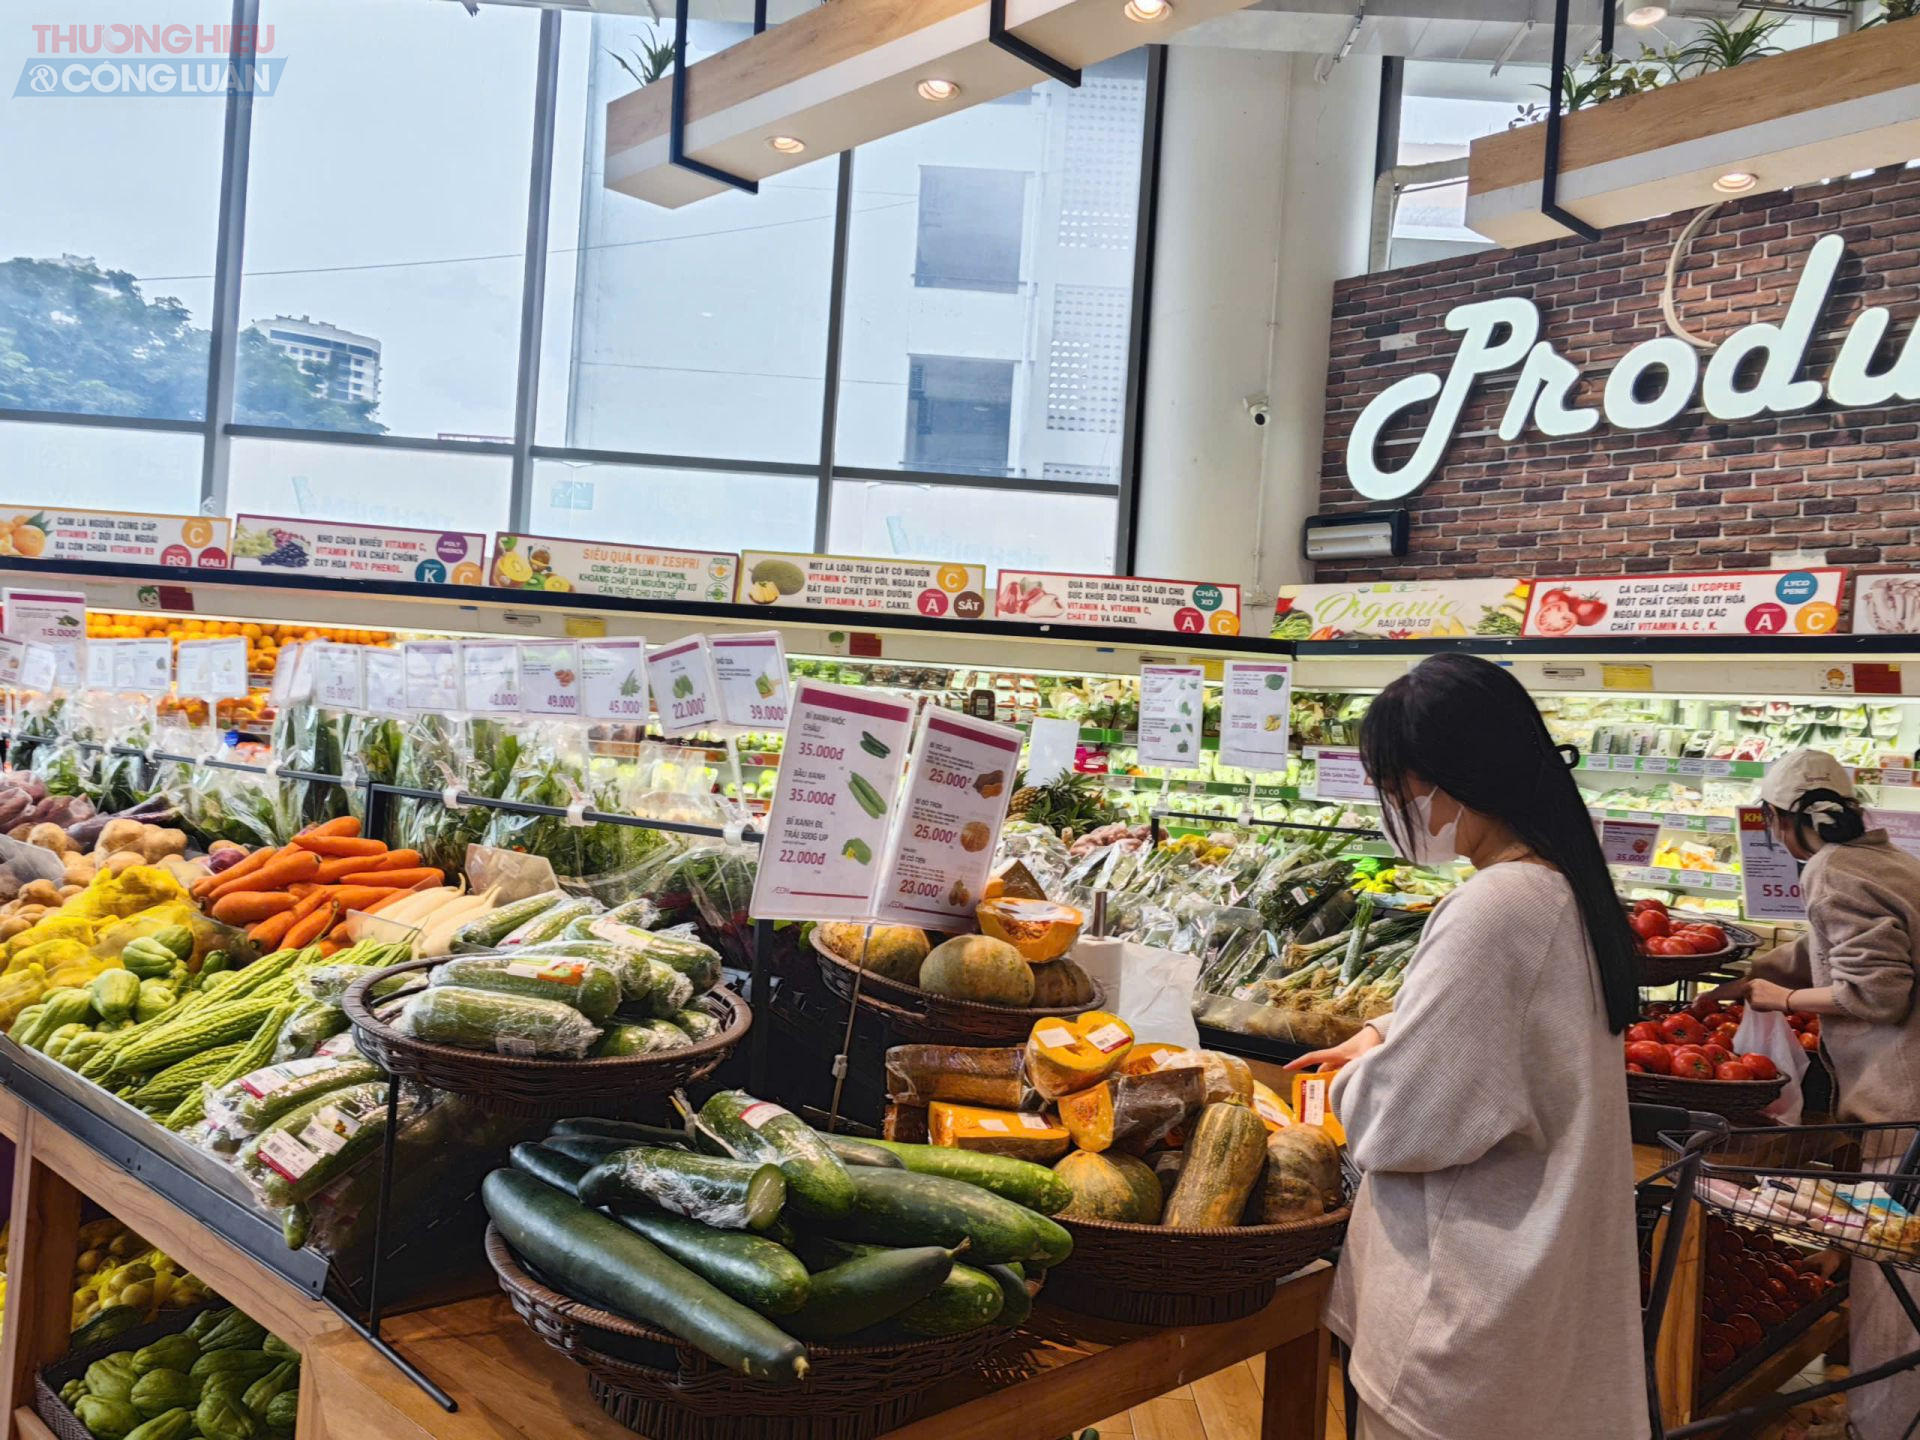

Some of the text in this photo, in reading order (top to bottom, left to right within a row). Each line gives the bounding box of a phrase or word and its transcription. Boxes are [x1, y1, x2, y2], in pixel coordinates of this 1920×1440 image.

[190, 528, 204, 544] C
[945, 573, 958, 588] C
[1692, 582, 1742, 592] LYCOPENE
[926, 598, 940, 614] A
[1068, 602, 1098, 610] VITAMIN
[1111, 604, 1142, 614] VITAMIN
[1314, 592, 1464, 629] Organic
[1181, 616, 1195, 631] A
[1217, 620, 1232, 634] C
[1638, 622, 1677, 630] VITAMIN
[1754, 613, 1774, 630] A
[1806, 612, 1824, 630] C
[798, 742, 844, 760] 35.000đ
[789, 788, 836, 806] 35.000đ
[779, 849, 826, 866] 22.000đ
